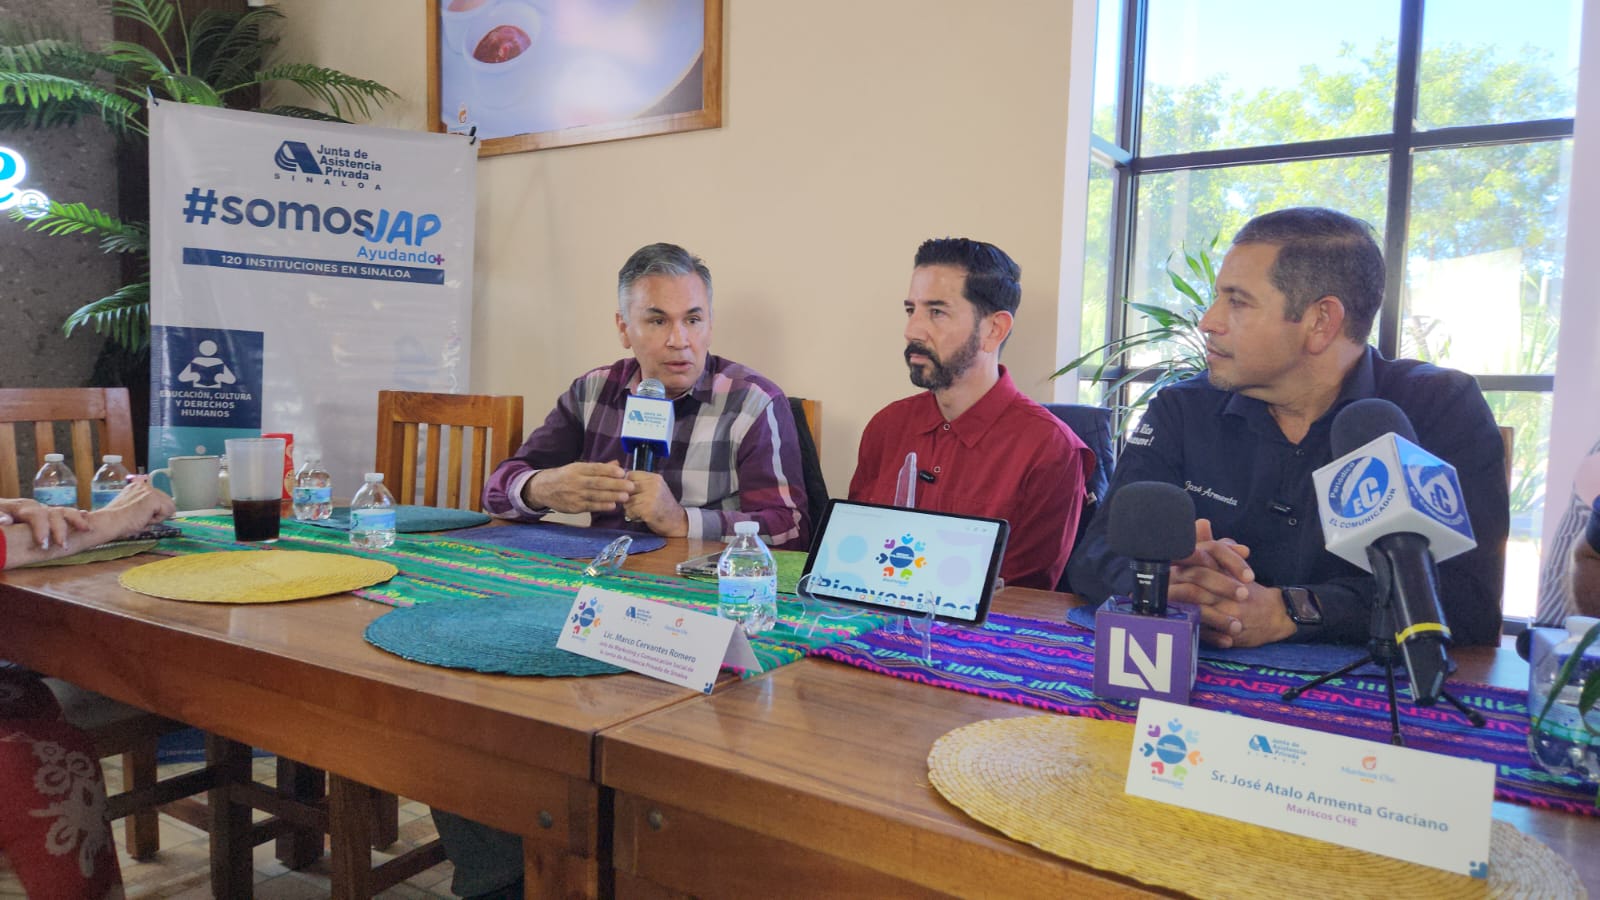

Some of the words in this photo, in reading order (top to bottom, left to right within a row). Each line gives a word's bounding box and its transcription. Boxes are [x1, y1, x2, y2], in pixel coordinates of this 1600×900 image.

[317, 144, 350, 157] Junta
[354, 149, 368, 159] de
[320, 155, 382, 171] Asistencia
[274, 173, 381, 190] SINALOA
[325, 166, 369, 180] Privada
[220, 255, 242, 265] 120
[246, 257, 338, 273] INSTITUCIONES
[341, 265, 357, 275] EN
[360, 267, 411, 279] SINALOA
[184, 400, 235, 409] DERECHOS
[214, 392, 252, 401] CULTURA
[181, 409, 230, 418] HUMANOS
[1330, 461, 1356, 499] Periódico
[1184, 480, 1202, 493] José
[1200, 487, 1238, 506] Armenta
[1352, 477, 1381, 515] EC
[1329, 518, 1338, 527] EL
[1340, 488, 1396, 528] COMUNICADOR
[603, 631, 615, 640] Lic.
[615, 633, 635, 645] Marco
[635, 639, 668, 655] Cervantes
[669, 648, 696, 663] Romero
[1210, 769, 1228, 784] Sr.
[1230, 774, 1261, 791] José
[1264, 782, 1303, 800] Atalo
[1306, 791, 1373, 815] Armenta
[1376, 806, 1449, 833] Graciano
[1286, 803, 1333, 821] Mariscos
[1335, 814, 1359, 827] CHE
